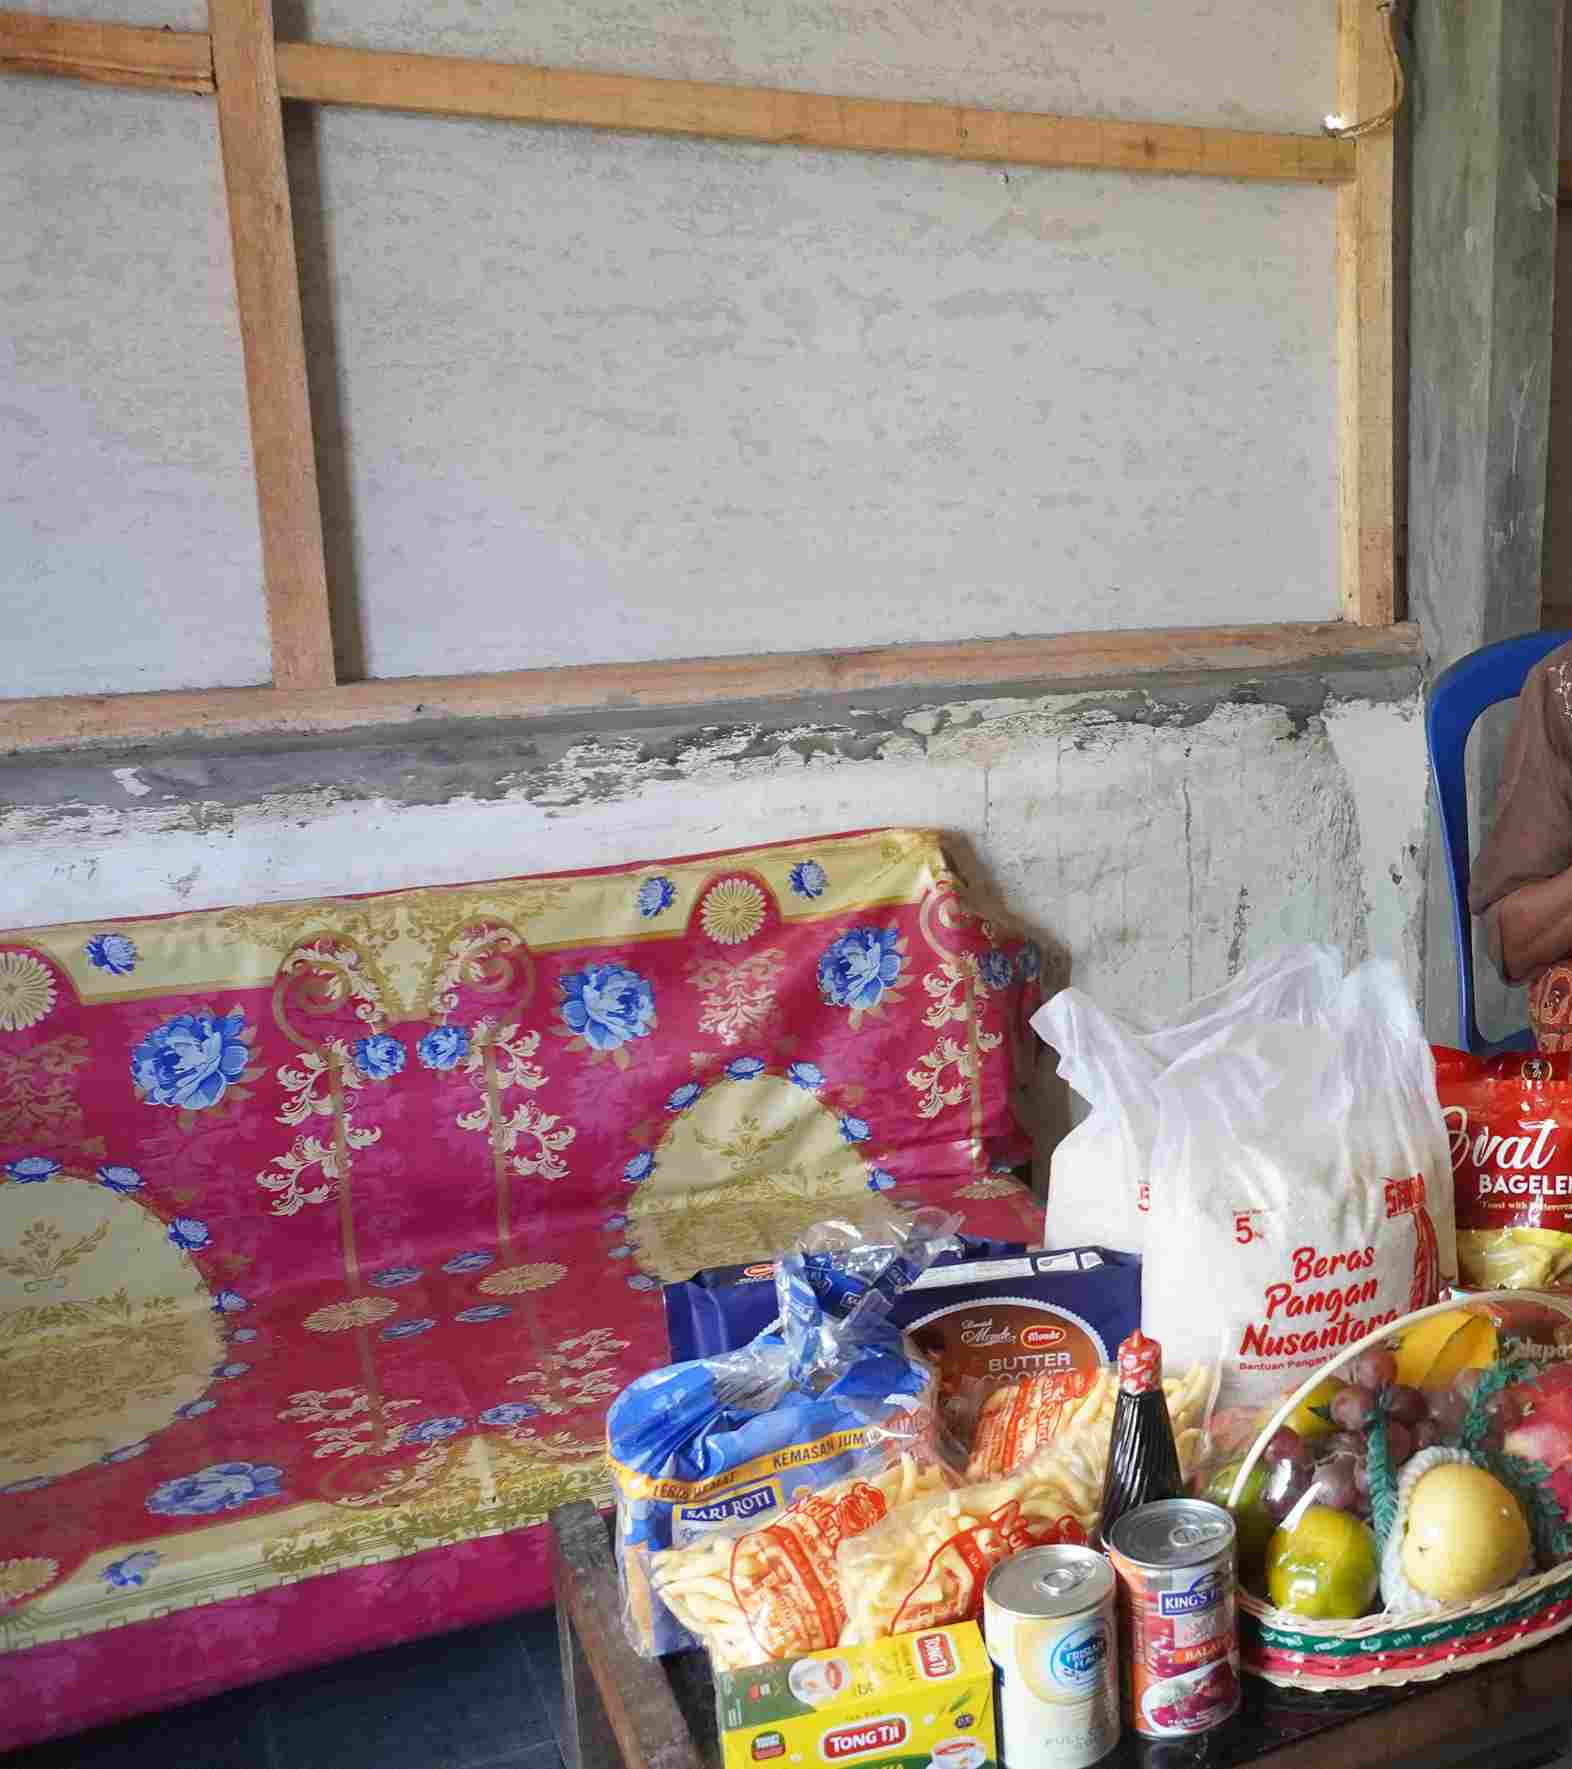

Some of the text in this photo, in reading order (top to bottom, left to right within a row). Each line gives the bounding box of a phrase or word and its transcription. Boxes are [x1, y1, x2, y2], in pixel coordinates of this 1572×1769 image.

[1235, 1216, 1253, 1244] 5
[1292, 1246, 1376, 1283] Beras
[1264, 1278, 1378, 1322] Pangan
[988, 1352, 1072, 1372] BUTTER
[772, 1437, 834, 1470] KEMASAN
[686, 1490, 771, 1520] SARI ROTI
[829, 1731, 877, 1752] TONG
